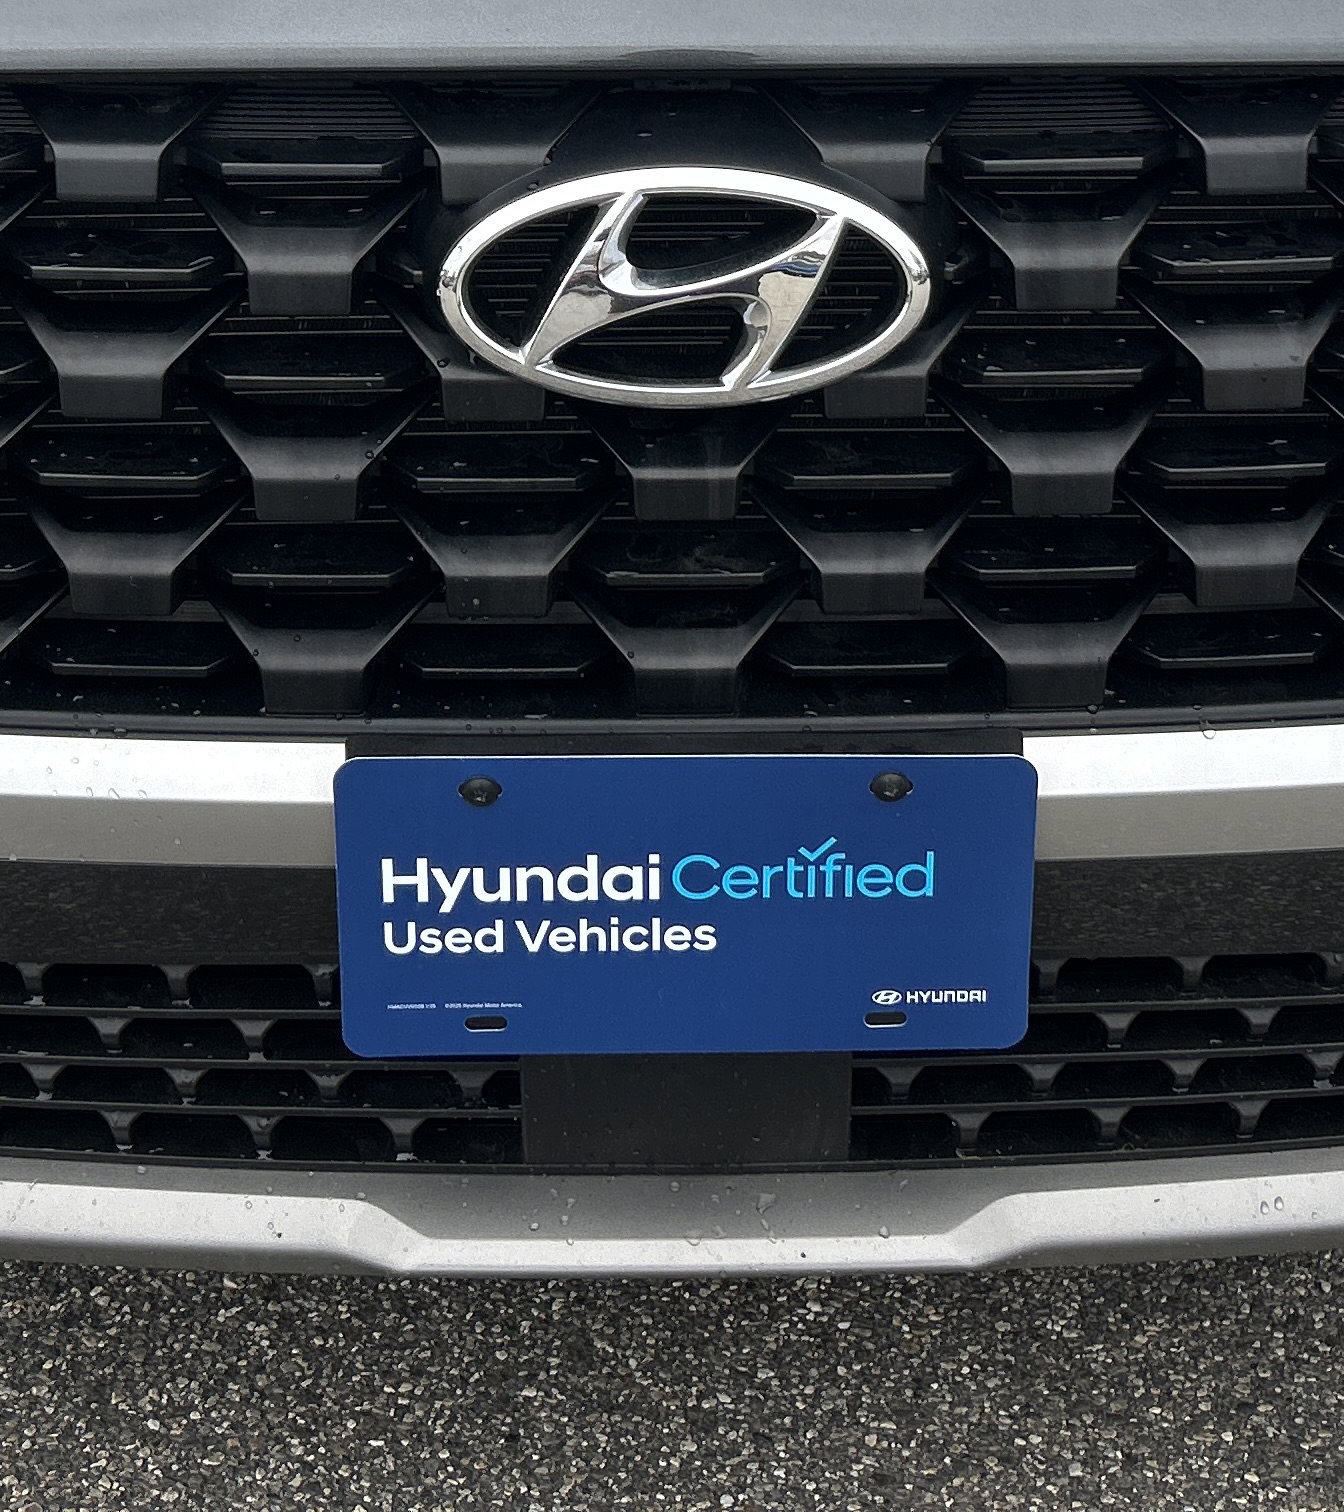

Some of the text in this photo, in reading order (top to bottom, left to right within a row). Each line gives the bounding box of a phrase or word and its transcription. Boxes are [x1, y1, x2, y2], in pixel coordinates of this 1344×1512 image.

[380, 837, 936, 913] Hyundai Certified
[382, 916, 719, 956] Used Vehicles
[905, 989, 988, 1004] HYUNDAI
